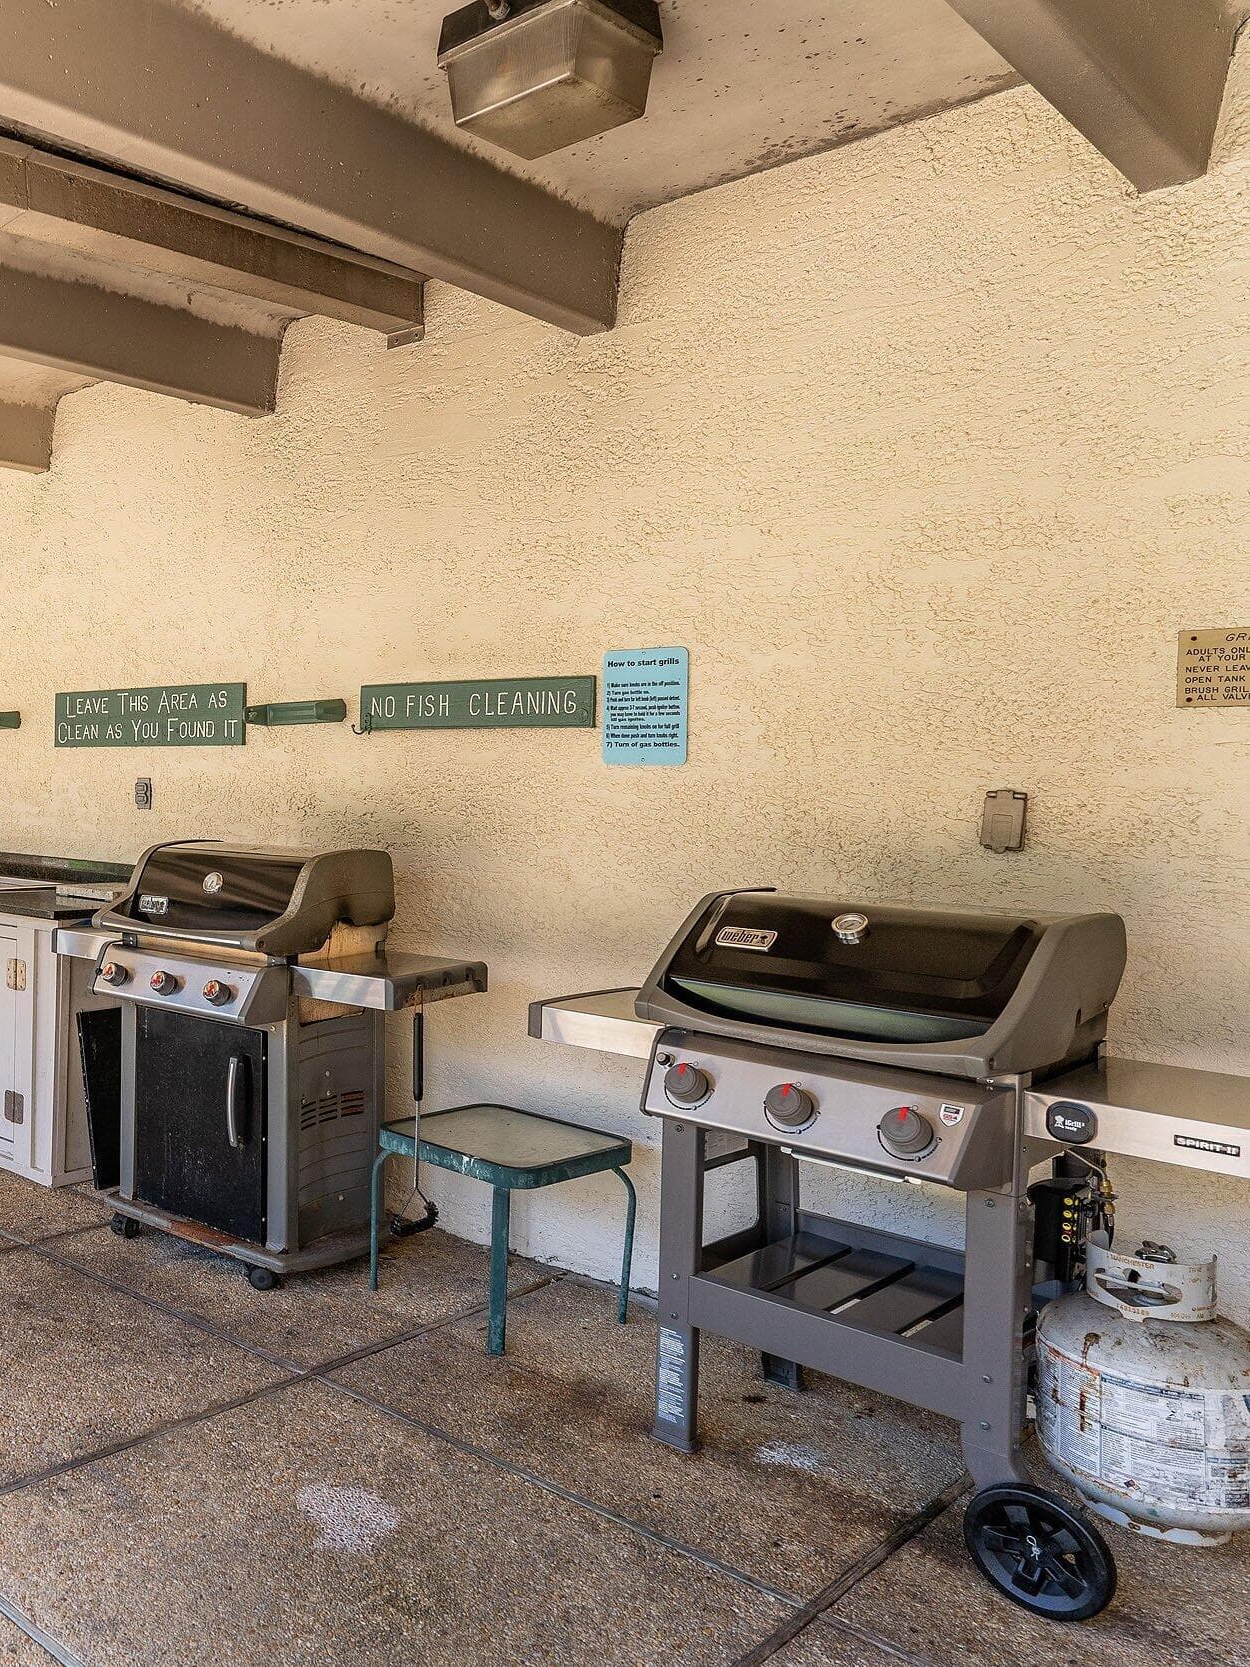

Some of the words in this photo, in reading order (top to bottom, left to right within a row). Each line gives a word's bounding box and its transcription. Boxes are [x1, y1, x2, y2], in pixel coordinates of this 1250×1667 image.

[1225, 632, 1250, 641] GR
[659, 658, 679, 666] grills
[1185, 676, 1212, 684] OPEN
[1184, 686, 1219, 694] BRUSH
[66, 696, 109, 718] LEAVE
[117, 693, 149, 715] THIS
[158, 690, 198, 714] AREA
[208, 690, 228, 708] AS
[371, 696, 395, 718] NO
[406, 694, 449, 718] FISH
[469, 690, 577, 716] CLEANING
[58, 722, 99, 744] CLEAN
[106, 723, 123, 739] AS
[131, 719, 158, 742] YOU
[167, 718, 215, 741] FOUND
[224, 720, 238, 738] IT
[720, 930, 759, 943] weber
[1177, 1137, 1223, 1152] SPIRIT
